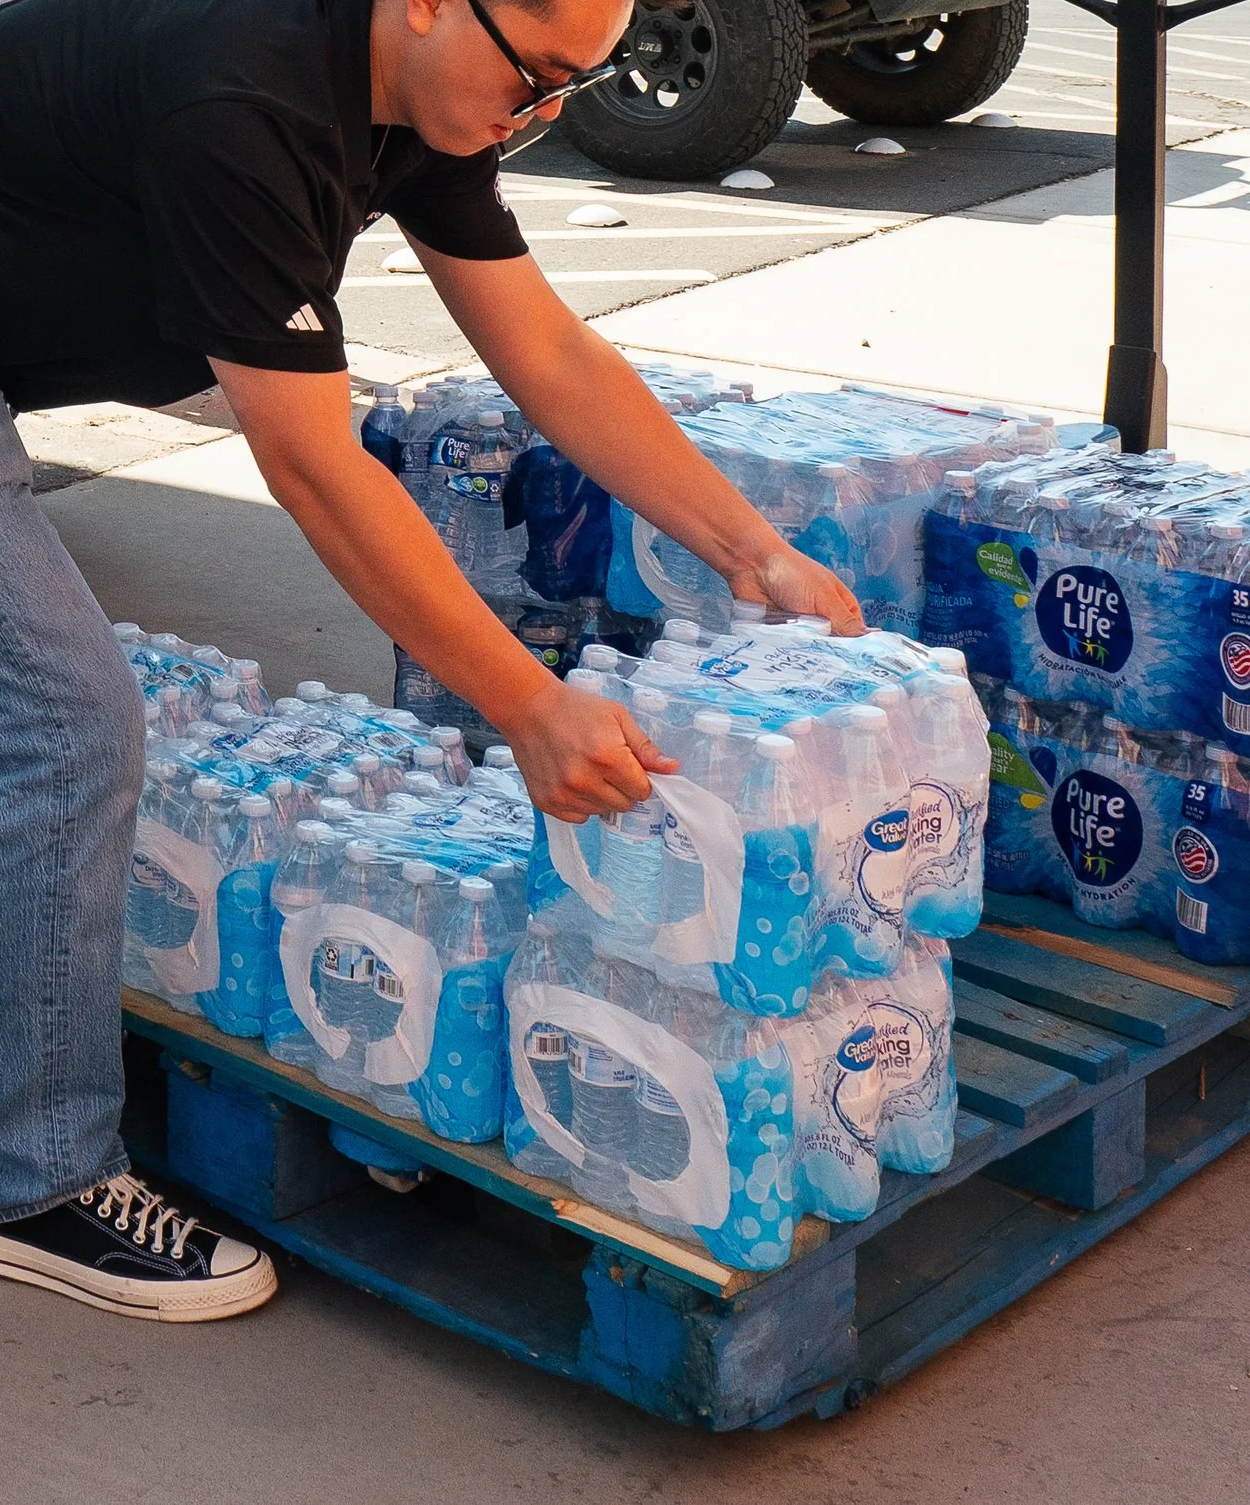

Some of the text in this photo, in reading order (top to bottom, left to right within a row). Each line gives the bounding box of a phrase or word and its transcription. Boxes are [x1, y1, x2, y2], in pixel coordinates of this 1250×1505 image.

[448, 437, 470, 451] Pure
[448, 446, 466, 459] Life
[979, 550, 1014, 565] Calidad
[1056, 573, 1119, 614] Pure
[1232, 589, 1249, 608] 35
[1063, 602, 1111, 639] Life
[991, 746, 1015, 763] ality
[1066, 778, 1125, 819] Pure
[1187, 783, 1207, 802] 35
[911, 816, 942, 834] king
[1070, 807, 1116, 849] Life
[913, 833, 942, 849] ater
[1080, 877, 1138, 901] HYDRATION
[877, 1039, 911, 1055] king
[880, 1055, 912, 1071] ater
[831, 1135, 841, 1147] OZ
[834, 1148, 855, 1167] TOTAL
